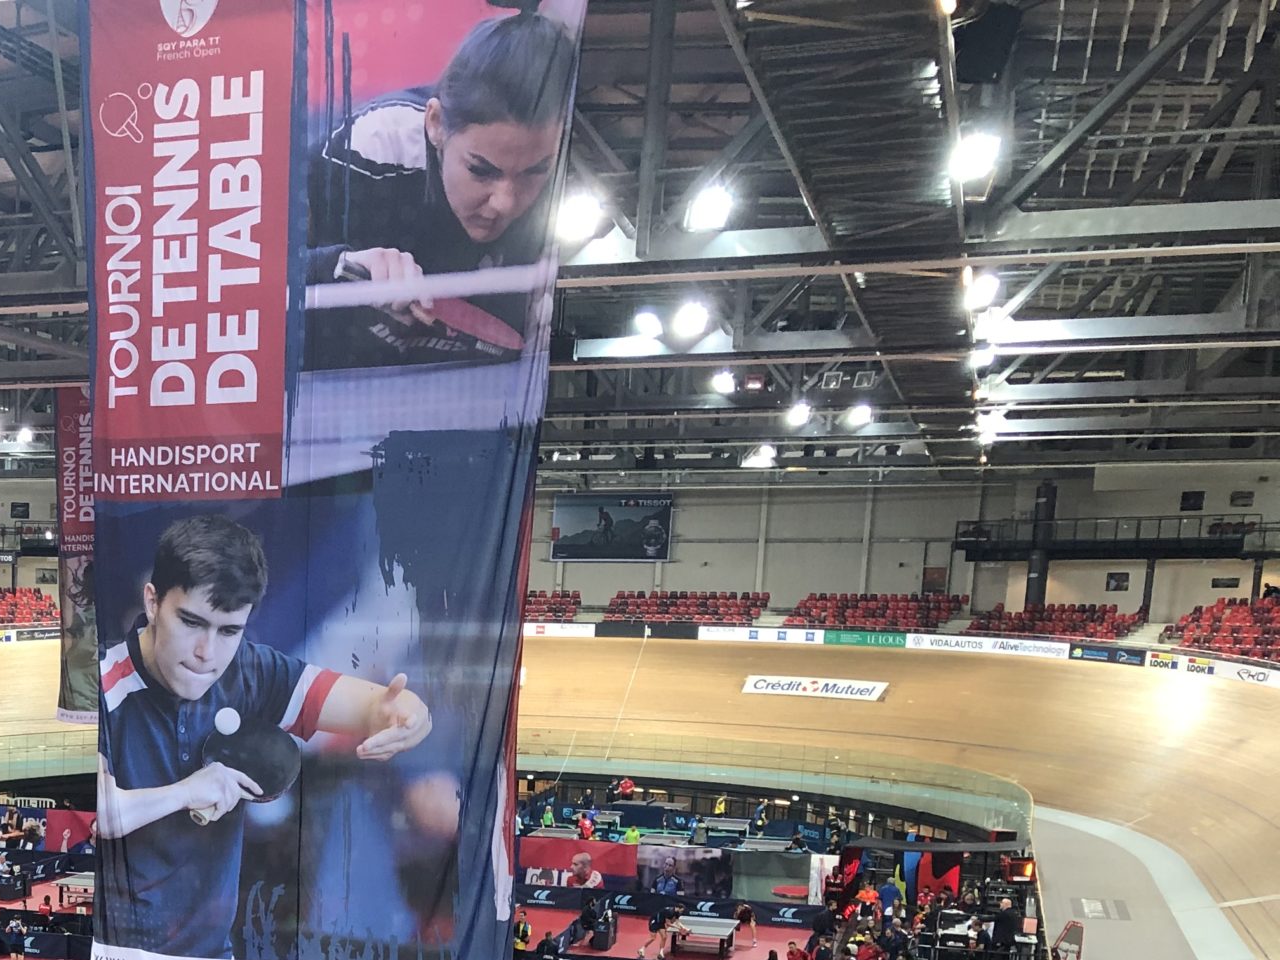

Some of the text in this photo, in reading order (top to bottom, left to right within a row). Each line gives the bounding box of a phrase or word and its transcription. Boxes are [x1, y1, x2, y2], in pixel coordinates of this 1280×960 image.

[156, 47, 221, 62] French Open
[157, 36, 221, 52] SQY PARA TT
[150, 77, 200, 407] DE TENNIS
[205, 69, 264, 405] DE TABLE
[105, 184, 142, 409] TOURNOI
[110, 442, 261, 467] HANDISPORT
[78, 411, 95, 522] DE TENNIS
[62, 446, 76, 523] TOURNOI
[93, 470, 279, 495] INTERNATIONAL
[64, 534, 95, 543] HANDIS
[929, 638, 984, 649] VIDALAUTOS
[1149, 659, 1170, 669] LOOK
[1186, 663, 1207, 674] LOOK
[752, 678, 877, 697] Crédit Mutuel
